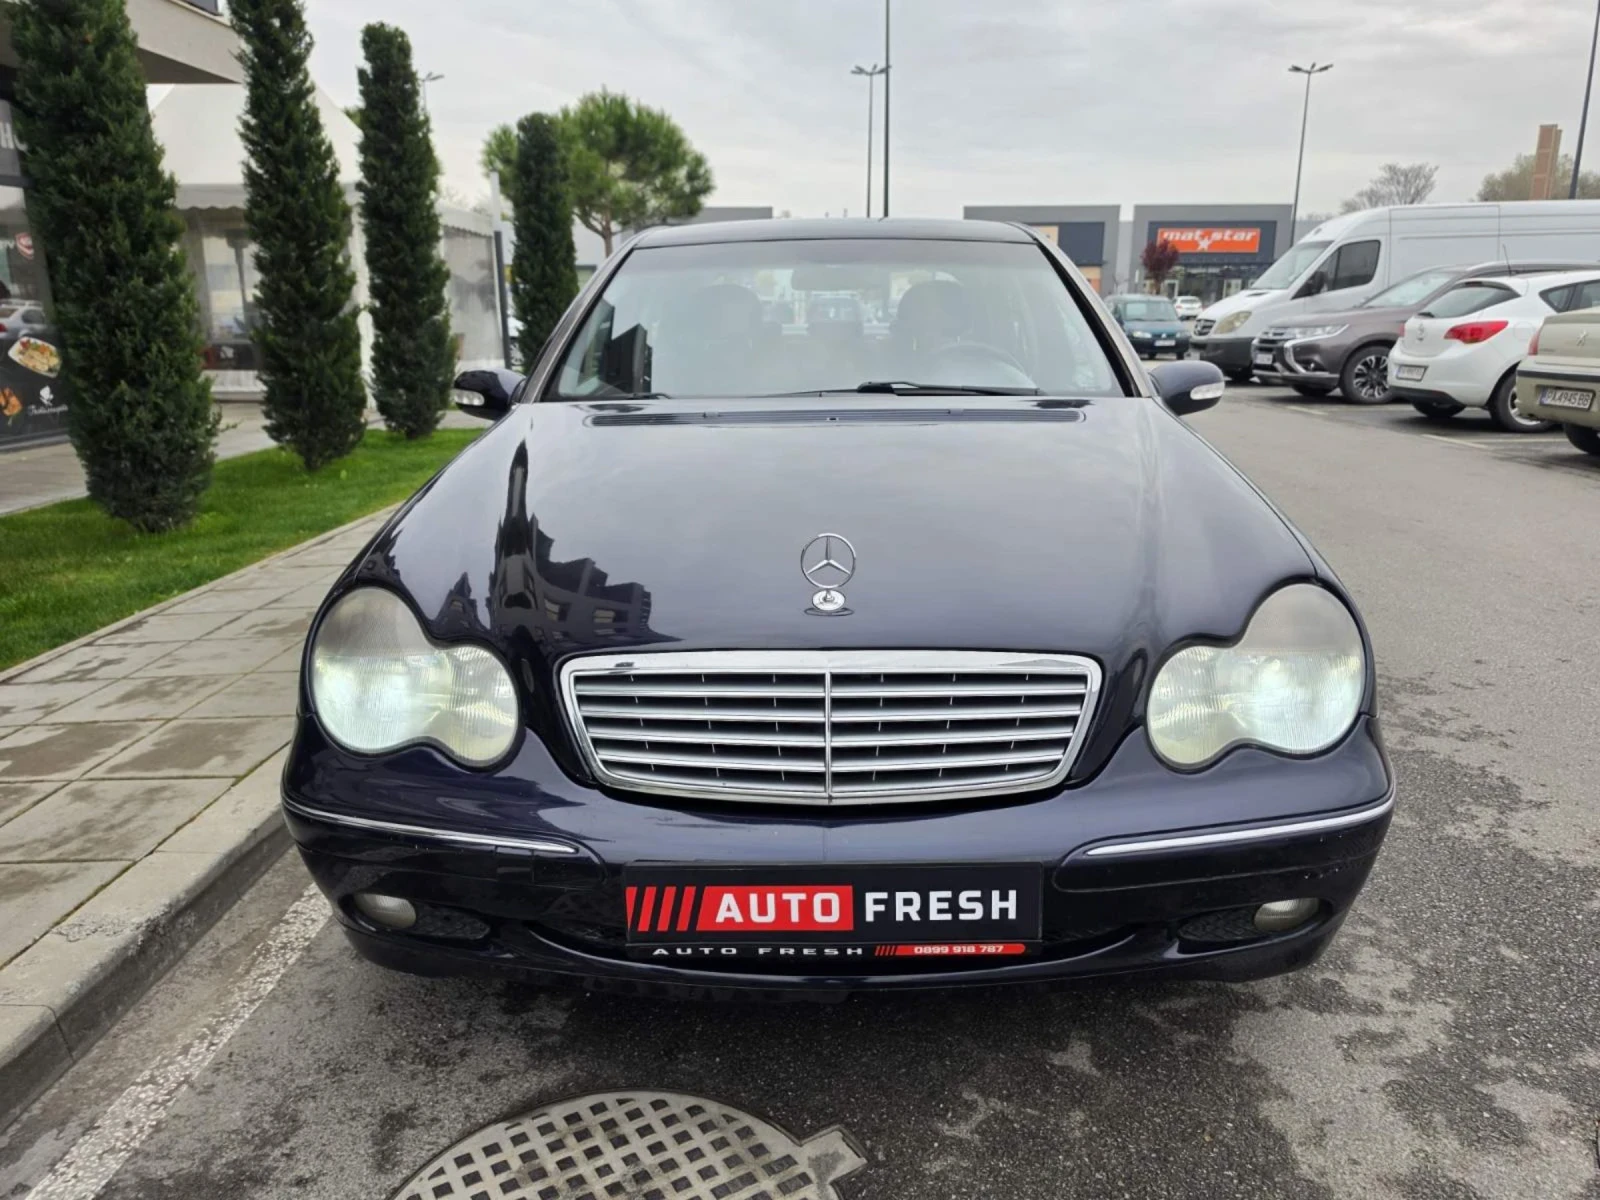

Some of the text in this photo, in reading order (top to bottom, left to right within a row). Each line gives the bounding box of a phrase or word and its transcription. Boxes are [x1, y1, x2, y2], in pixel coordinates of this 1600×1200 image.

[1211, 229, 1257, 241] star
[715, 889, 1017, 924] AUTO FRESH
[652, 947, 863, 956] AUTO FRESH
[913, 944, 1005, 955] 0899 918 787
